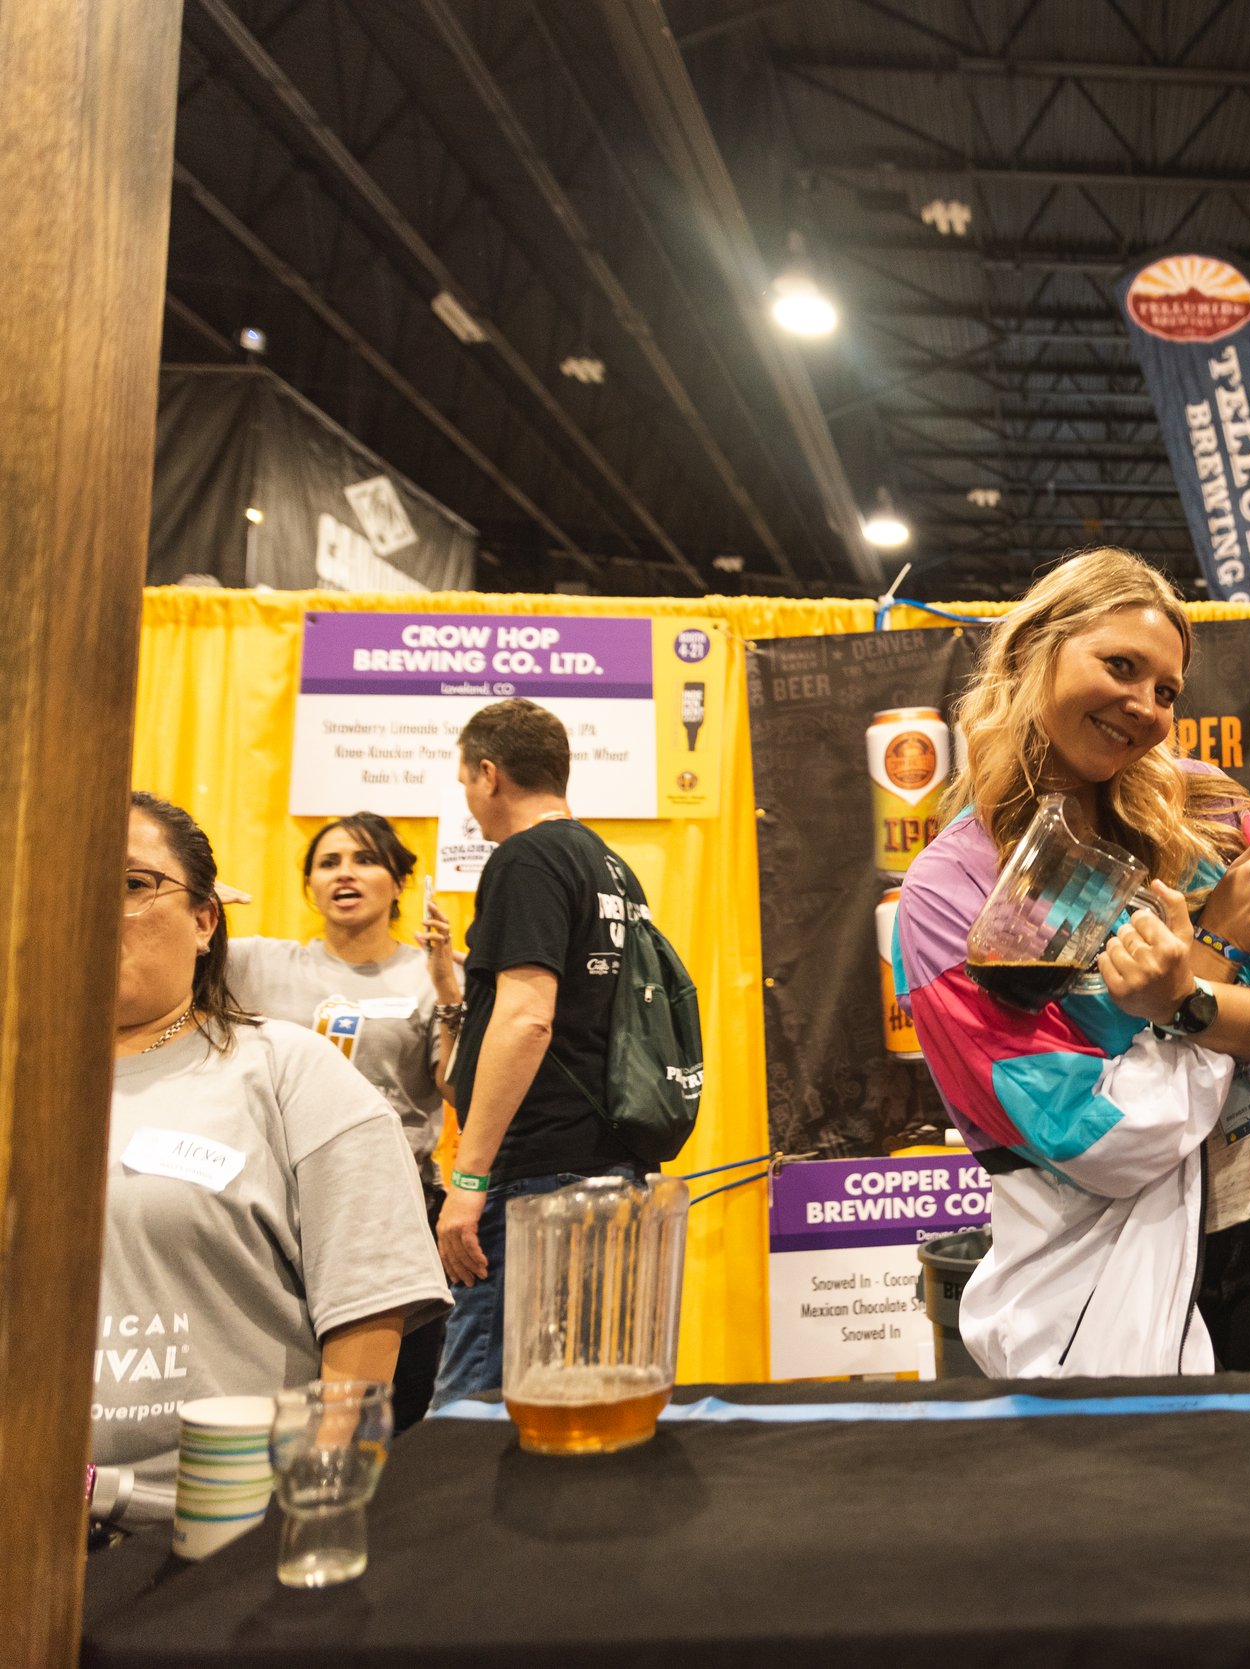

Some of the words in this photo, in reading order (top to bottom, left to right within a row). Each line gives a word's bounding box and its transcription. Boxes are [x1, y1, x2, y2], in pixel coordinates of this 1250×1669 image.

[1184, 399, 1246, 588] BREWING
[401, 624, 492, 648] CROW
[496, 626, 560, 650] HOP
[851, 630, 926, 662] DENVER
[353, 648, 487, 674] BREWING
[492, 650, 543, 675] CO.
[549, 652, 604, 675] LTD.
[493, 682, 516, 696] CO
[772, 673, 832, 702] BEER
[1172, 714, 1244, 769] PER
[844, 1168, 951, 1196] COPPER
[805, 1195, 938, 1224] BREWING
[811, 1273, 856, 1292] Snowed
[860, 1274, 871, 1289] In
[801, 1302, 849, 1318] Mexican
[852, 1297, 907, 1316] Chocolate
[842, 1325, 886, 1342] Snowed
[890, 1323, 901, 1339] In
